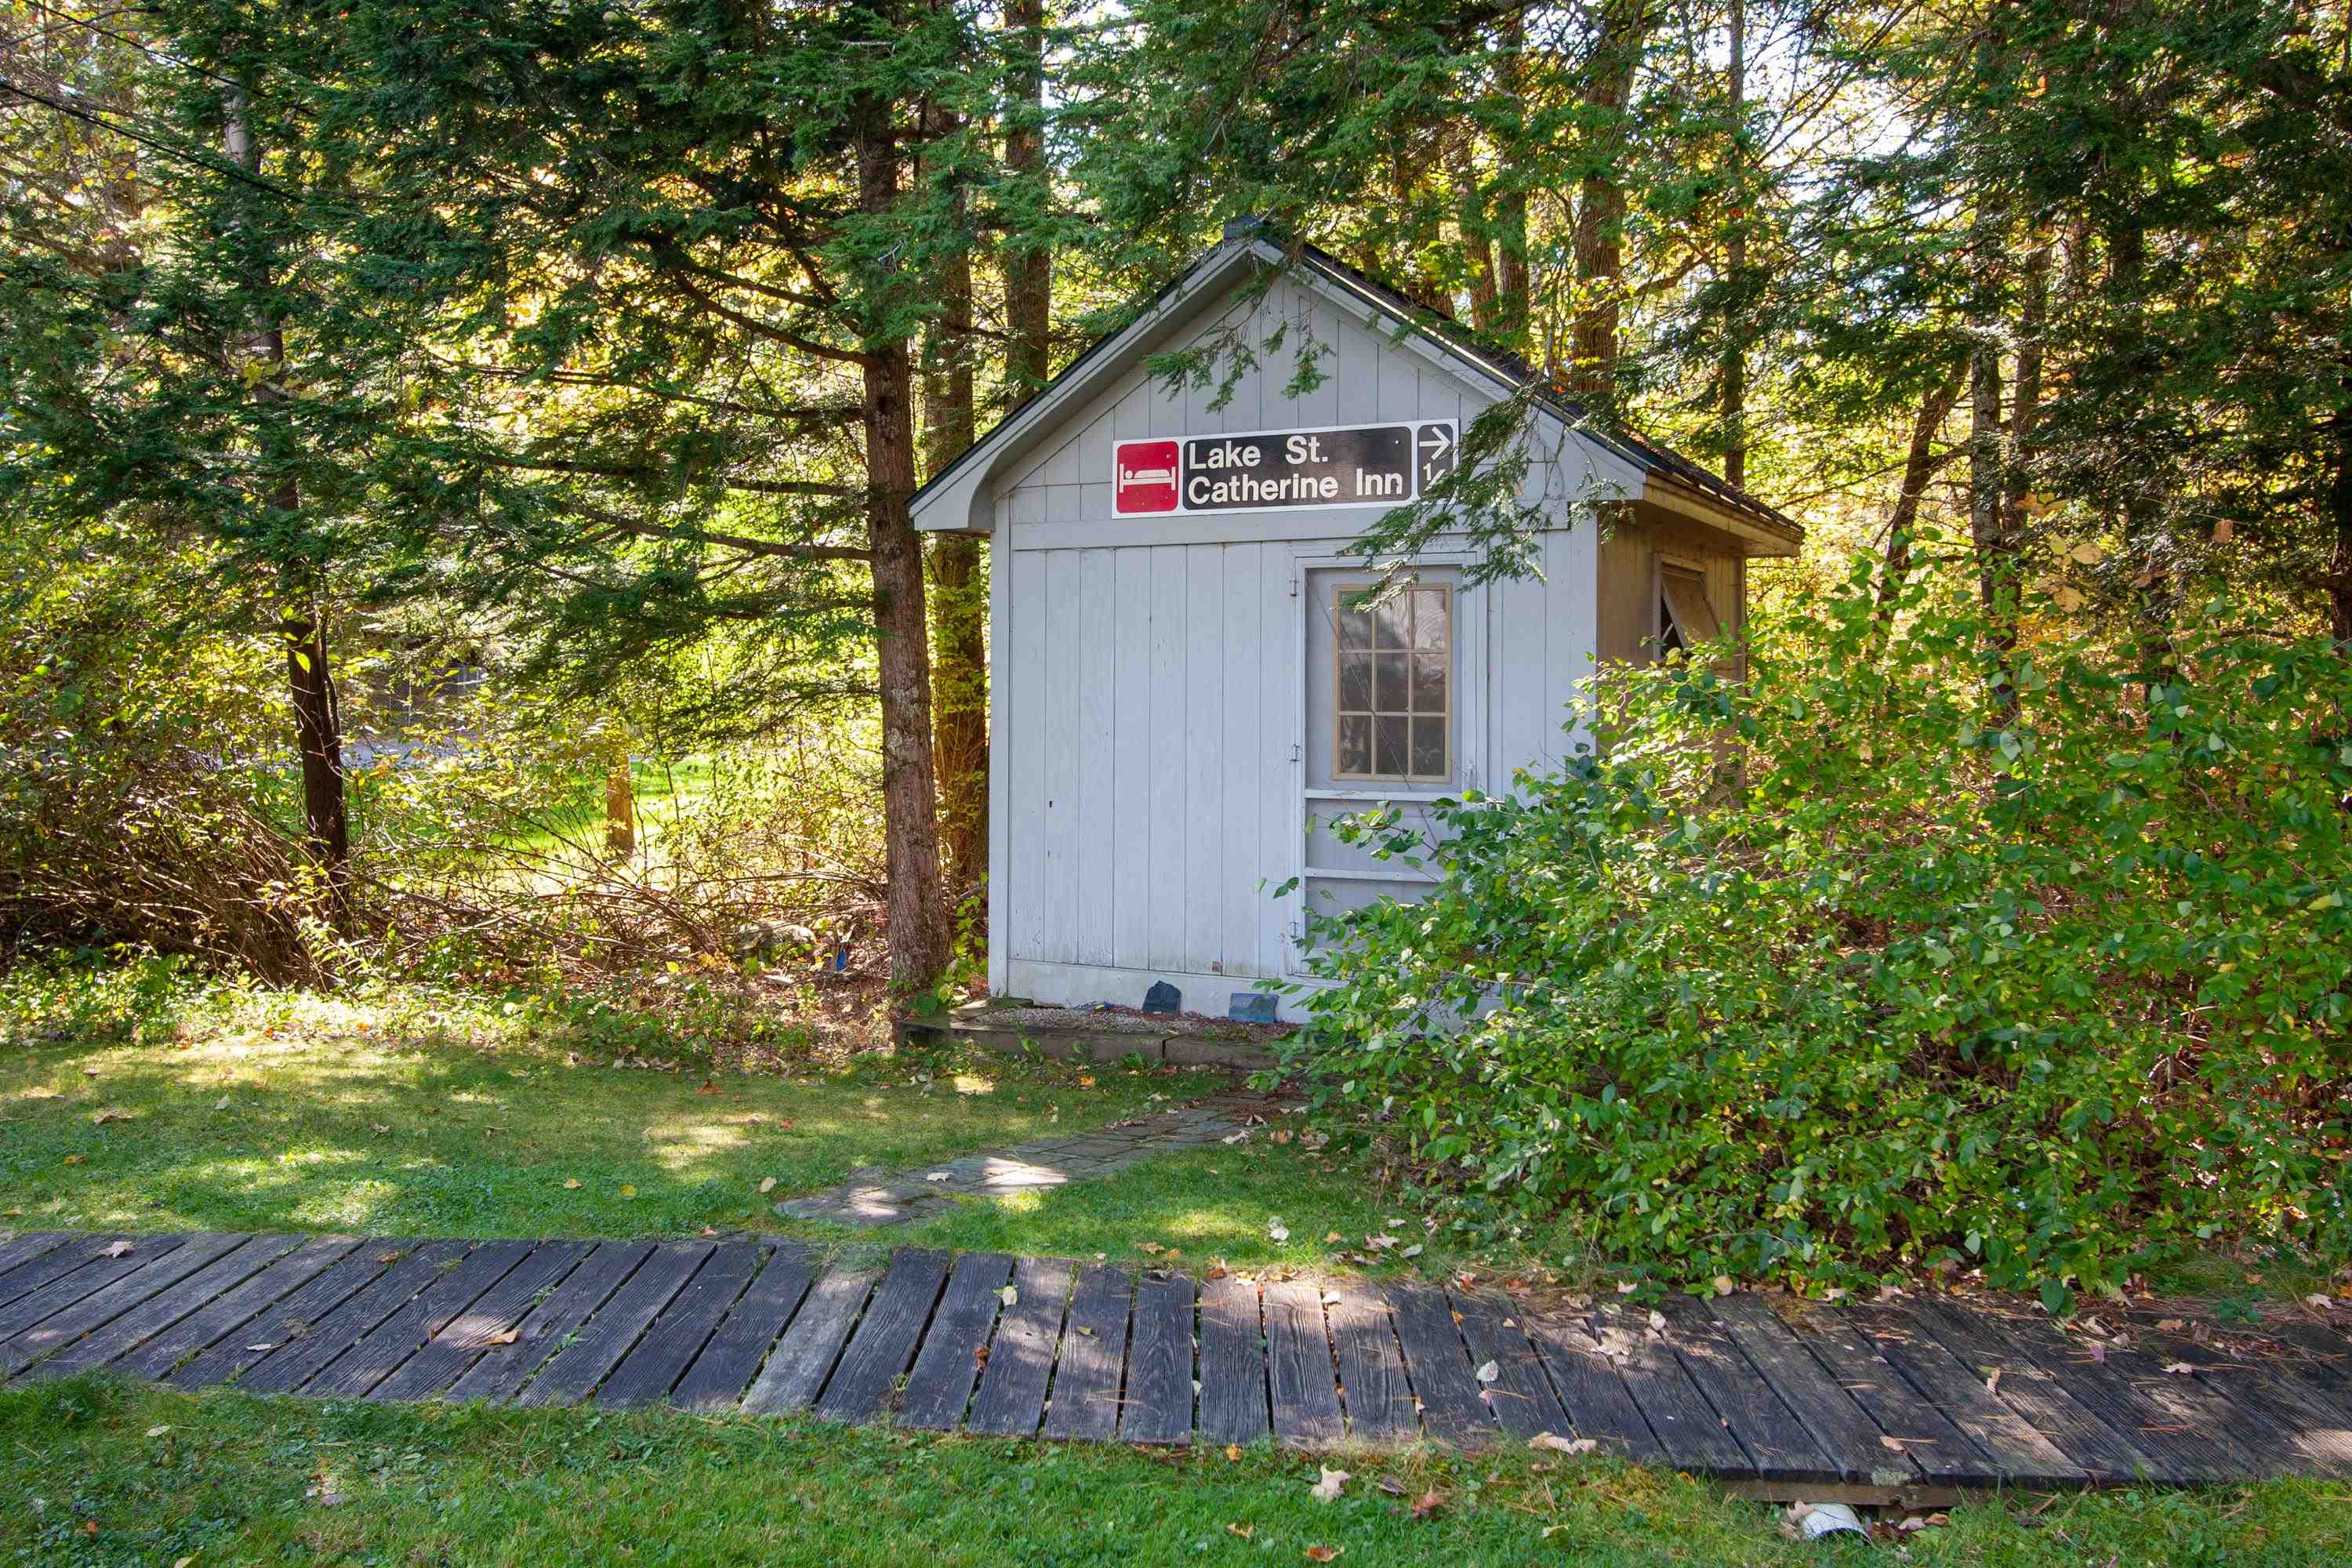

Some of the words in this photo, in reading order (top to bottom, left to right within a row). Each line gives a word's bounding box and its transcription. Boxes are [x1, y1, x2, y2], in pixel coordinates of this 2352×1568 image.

[1189, 441, 1261, 470] Lake
[1285, 435, 1329, 465] St.
[1188, 473, 1339, 504] Catherine
[1356, 467, 1403, 496] Inn
